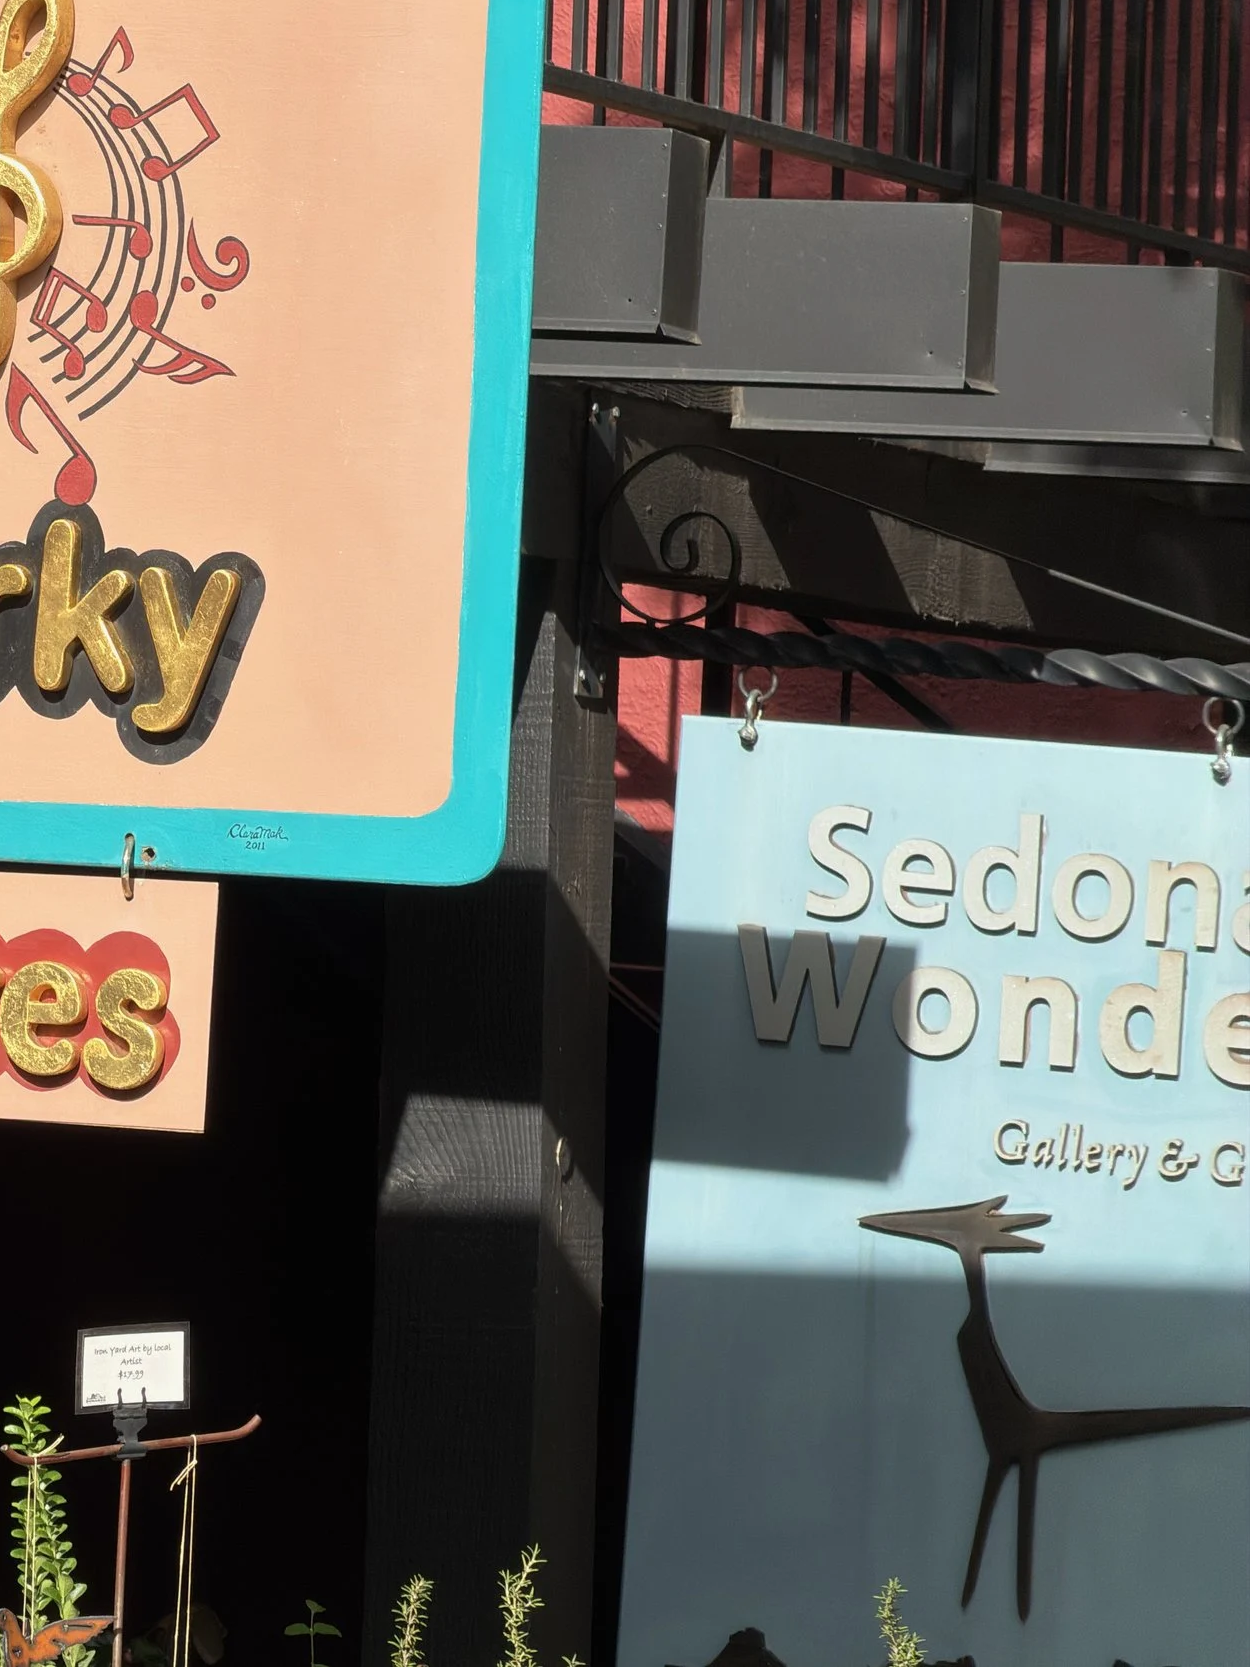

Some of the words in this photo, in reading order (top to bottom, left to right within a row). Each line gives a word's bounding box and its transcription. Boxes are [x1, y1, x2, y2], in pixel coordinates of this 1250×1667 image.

[245, 840, 266, 851] 2011
[805, 804, 1250, 956] Sedon
[737, 924, 1250, 1091] Wonde
[993, 1119, 1150, 1191] Gallery
[1157, 1138, 1200, 1182] &
[110, 1346, 127, 1357] Yard
[128, 1345, 141, 1353] Art
[142, 1343, 153, 1356] by
[154, 1343, 172, 1352] local
[120, 1357, 143, 1366] Artist
